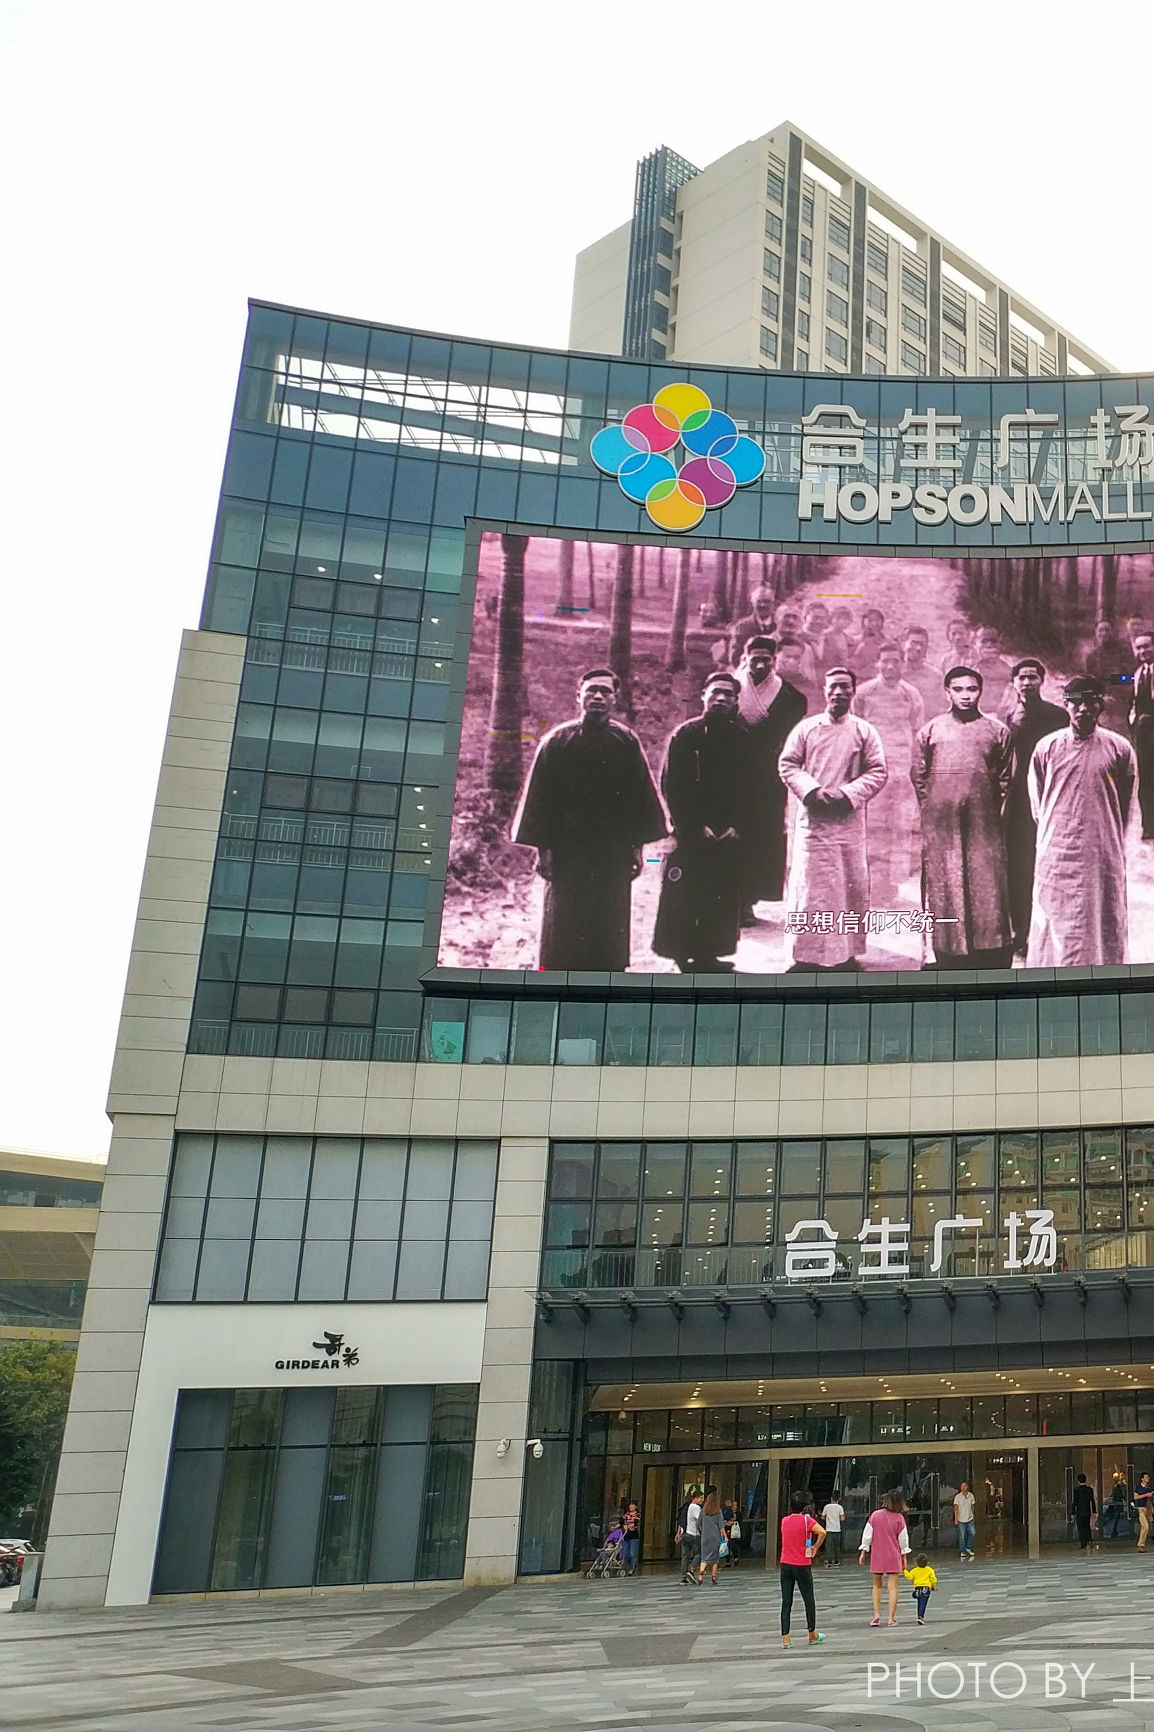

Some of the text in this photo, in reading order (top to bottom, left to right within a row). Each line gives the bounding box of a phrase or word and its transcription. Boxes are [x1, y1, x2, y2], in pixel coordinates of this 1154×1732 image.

[801, 404, 1154, 468] 合生广场
[785, 909, 959, 935] 思想信仰不统一
[785, 1209, 1057, 1278] 合生广场
[275, 1360, 340, 1370] GIRDEAR
